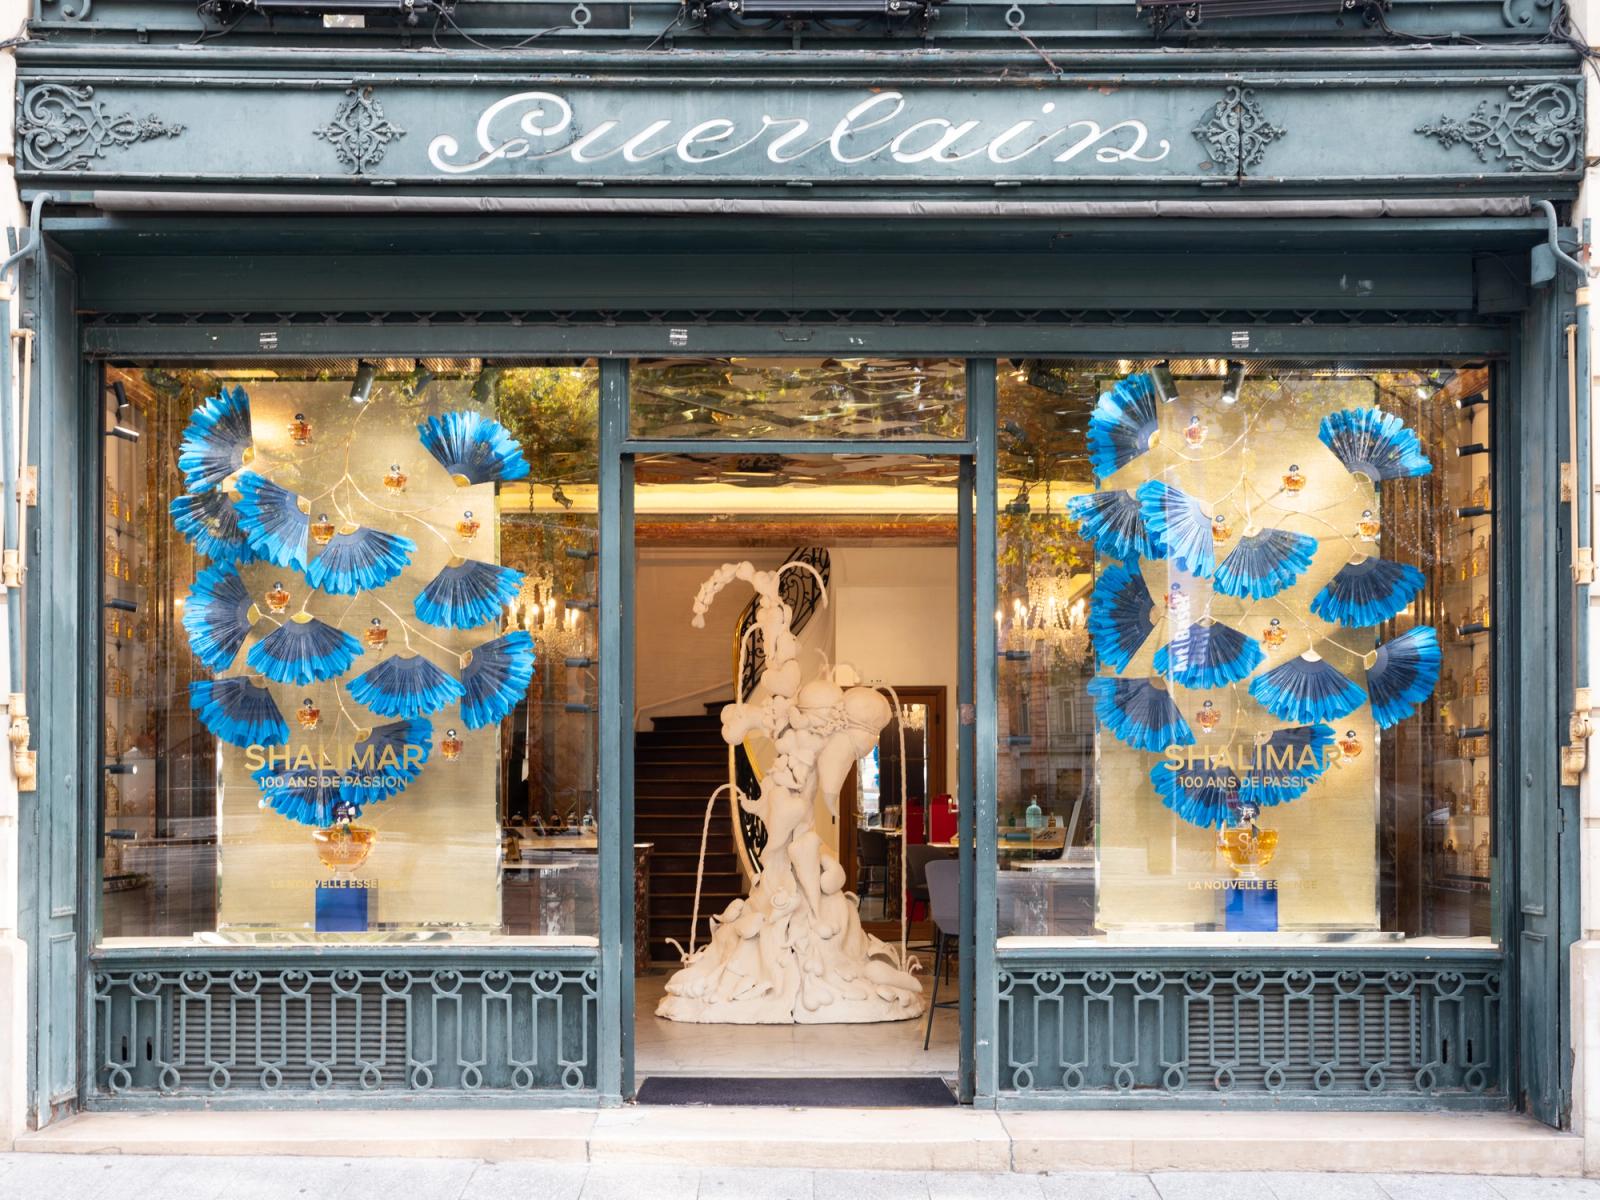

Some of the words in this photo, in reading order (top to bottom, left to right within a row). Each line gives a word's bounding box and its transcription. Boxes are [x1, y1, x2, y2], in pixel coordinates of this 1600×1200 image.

[428, 91, 1170, 173] Guerlain
[244, 744, 424, 771] SHALIMAR
[1164, 744, 1343, 771] SHALIMAR
[260, 776, 283, 788] 100
[288, 776, 317, 788] ANS
[321, 776, 340, 788] DE
[345, 776, 408, 788] PASSION
[1179, 776, 1202, 788] 100
[1206, 776, 1236, 788] ANS
[1241, 776, 1259, 788] DE
[1187, 880, 1201, 890] LA
[1203, 880, 1263, 890] NOUVELLE
